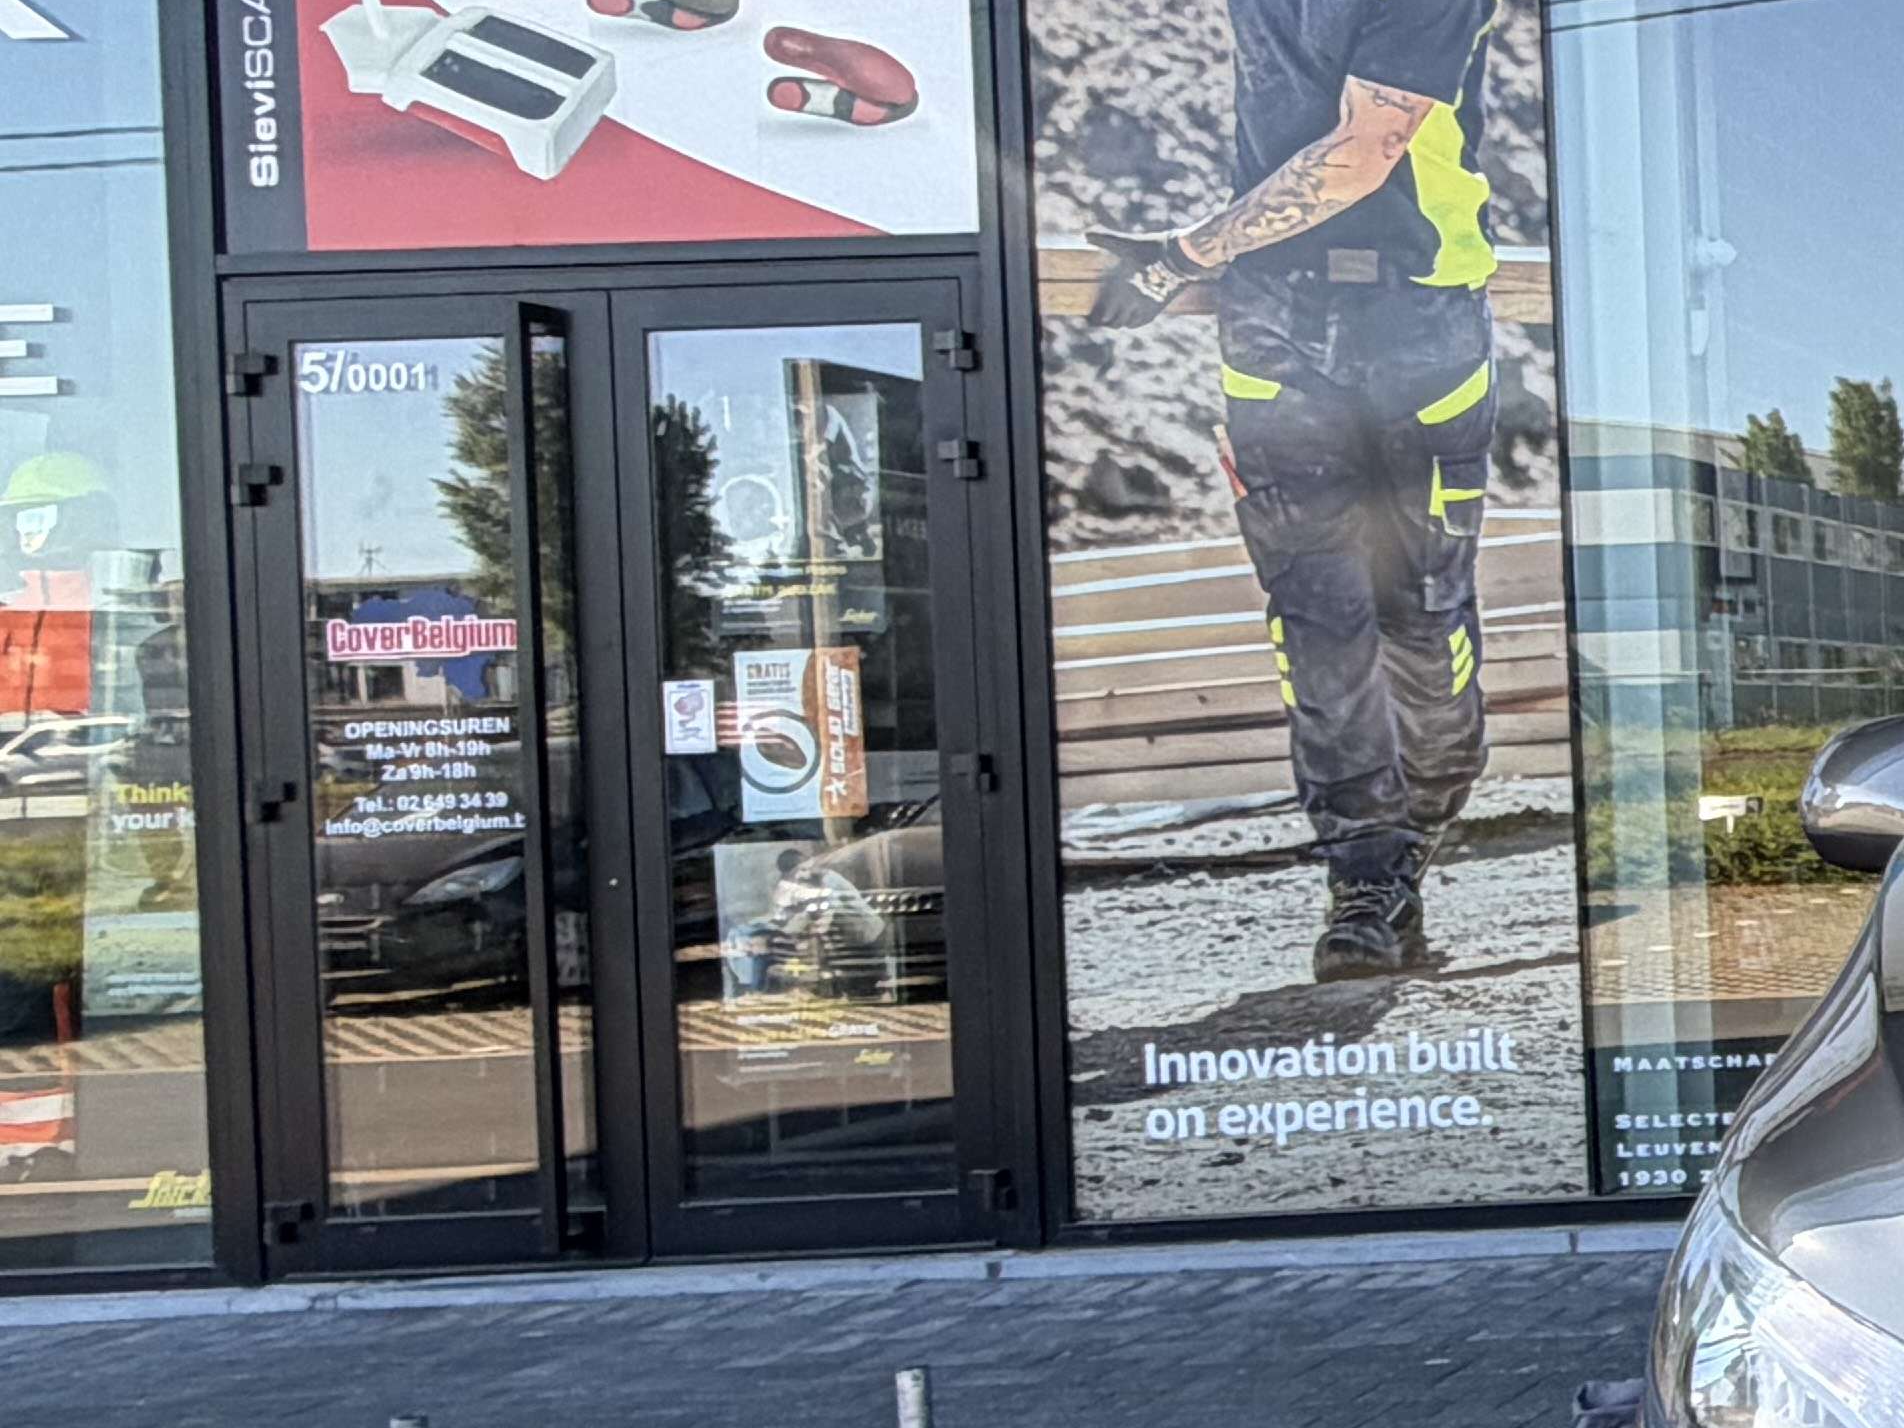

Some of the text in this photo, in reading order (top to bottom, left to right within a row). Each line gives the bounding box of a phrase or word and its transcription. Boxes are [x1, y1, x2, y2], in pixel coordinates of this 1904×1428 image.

[299, 349, 428, 395] 5/0001
[329, 615, 518, 653] CoverBelgium
[343, 716, 511, 740] OPENINGSUREN
[365, 741, 421, 761] Ma-Vr
[1144, 1027, 1519, 1087] Innovation built
[1146, 1085, 1496, 1146] on experience.
